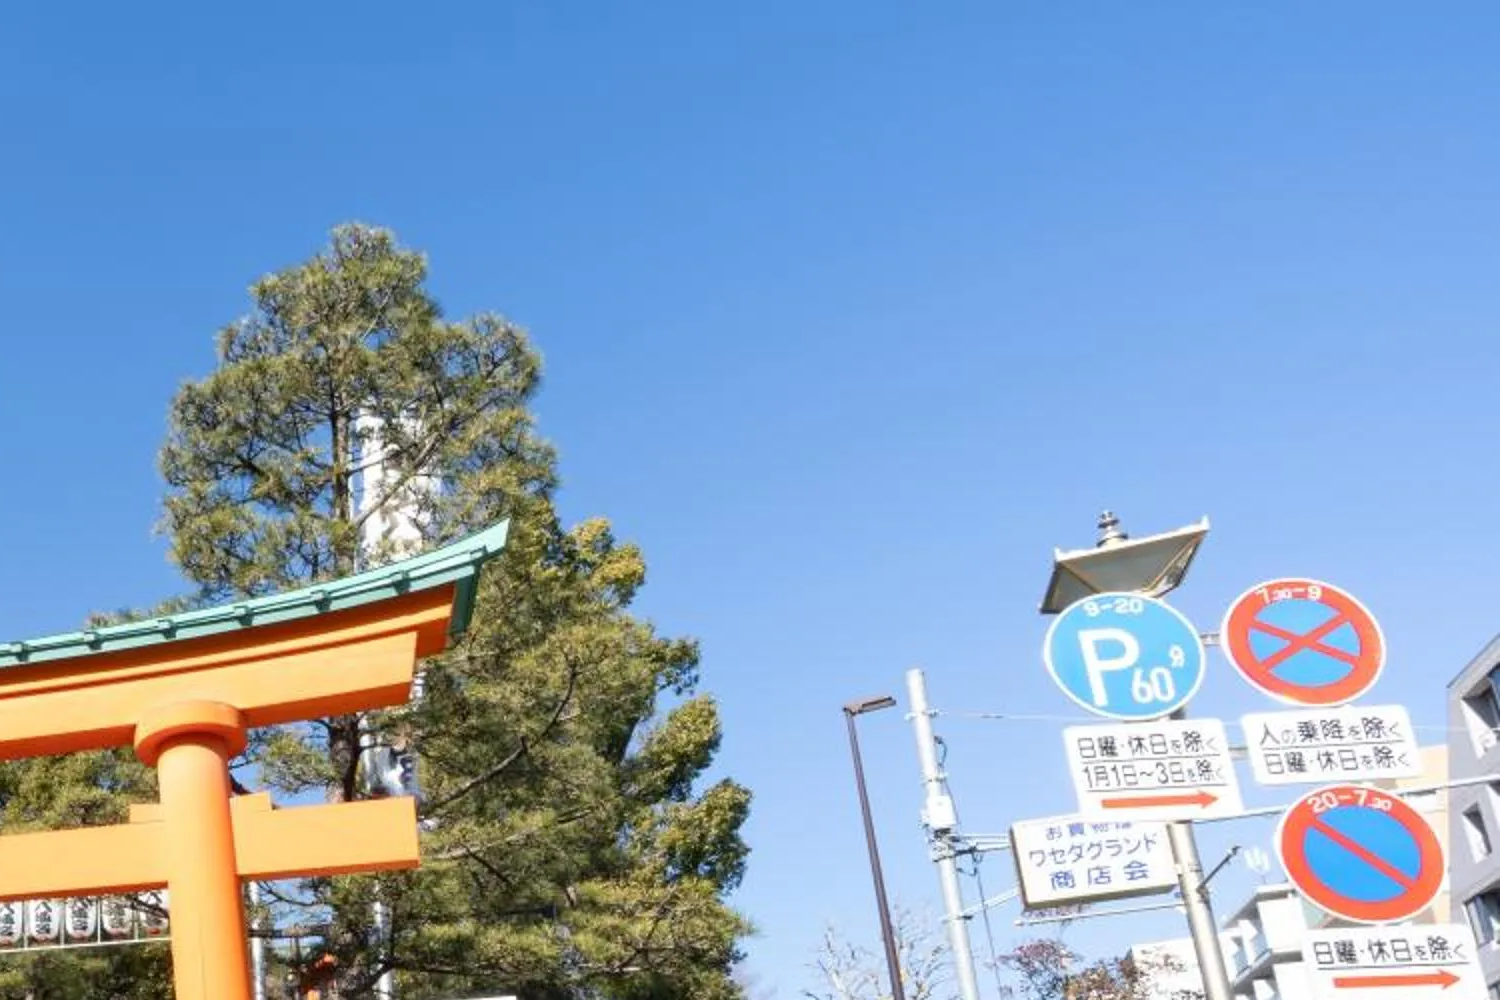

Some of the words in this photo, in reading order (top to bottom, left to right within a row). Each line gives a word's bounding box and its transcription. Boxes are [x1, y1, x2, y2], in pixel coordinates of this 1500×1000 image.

[1077, 627, 1140, 708] P
[1076, 731, 1219, 759] 日曜・休日を除く
[1259, 716, 1403, 746] 人の乗降を除く
[1264, 746, 1412, 775] 日曜・休日を除く
[1028, 831, 1158, 866] ワセダグランド
[1049, 860, 1150, 891] 商店会
[1313, 936, 1467, 965] 日曜・休日を除く
